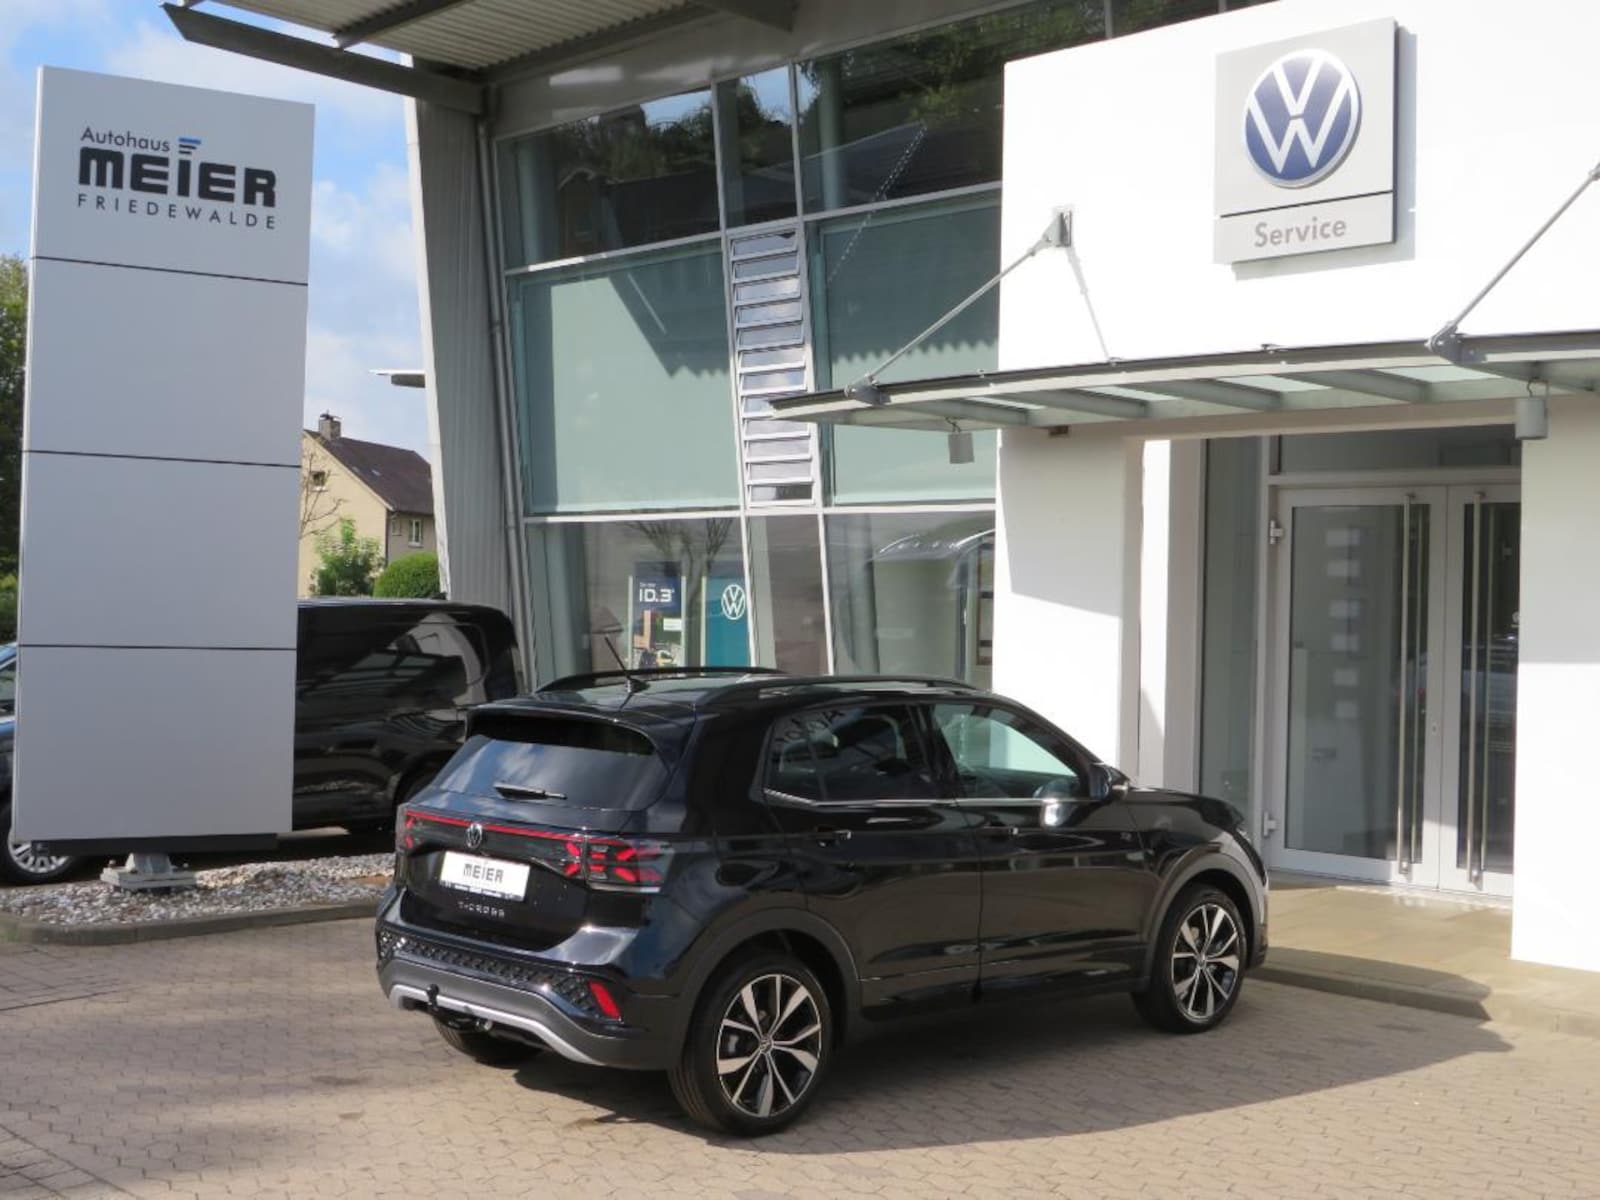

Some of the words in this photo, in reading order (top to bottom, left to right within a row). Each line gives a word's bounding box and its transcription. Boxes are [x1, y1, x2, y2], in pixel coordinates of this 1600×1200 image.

[1246, 52, 1354, 175] VW
[80, 126, 170, 152] Autohaus
[78, 144, 276, 208] MEIER
[77, 193, 275, 230] FRIEDEWALDE
[1255, 216, 1347, 248] Service
[463, 863, 504, 883] MEIER
